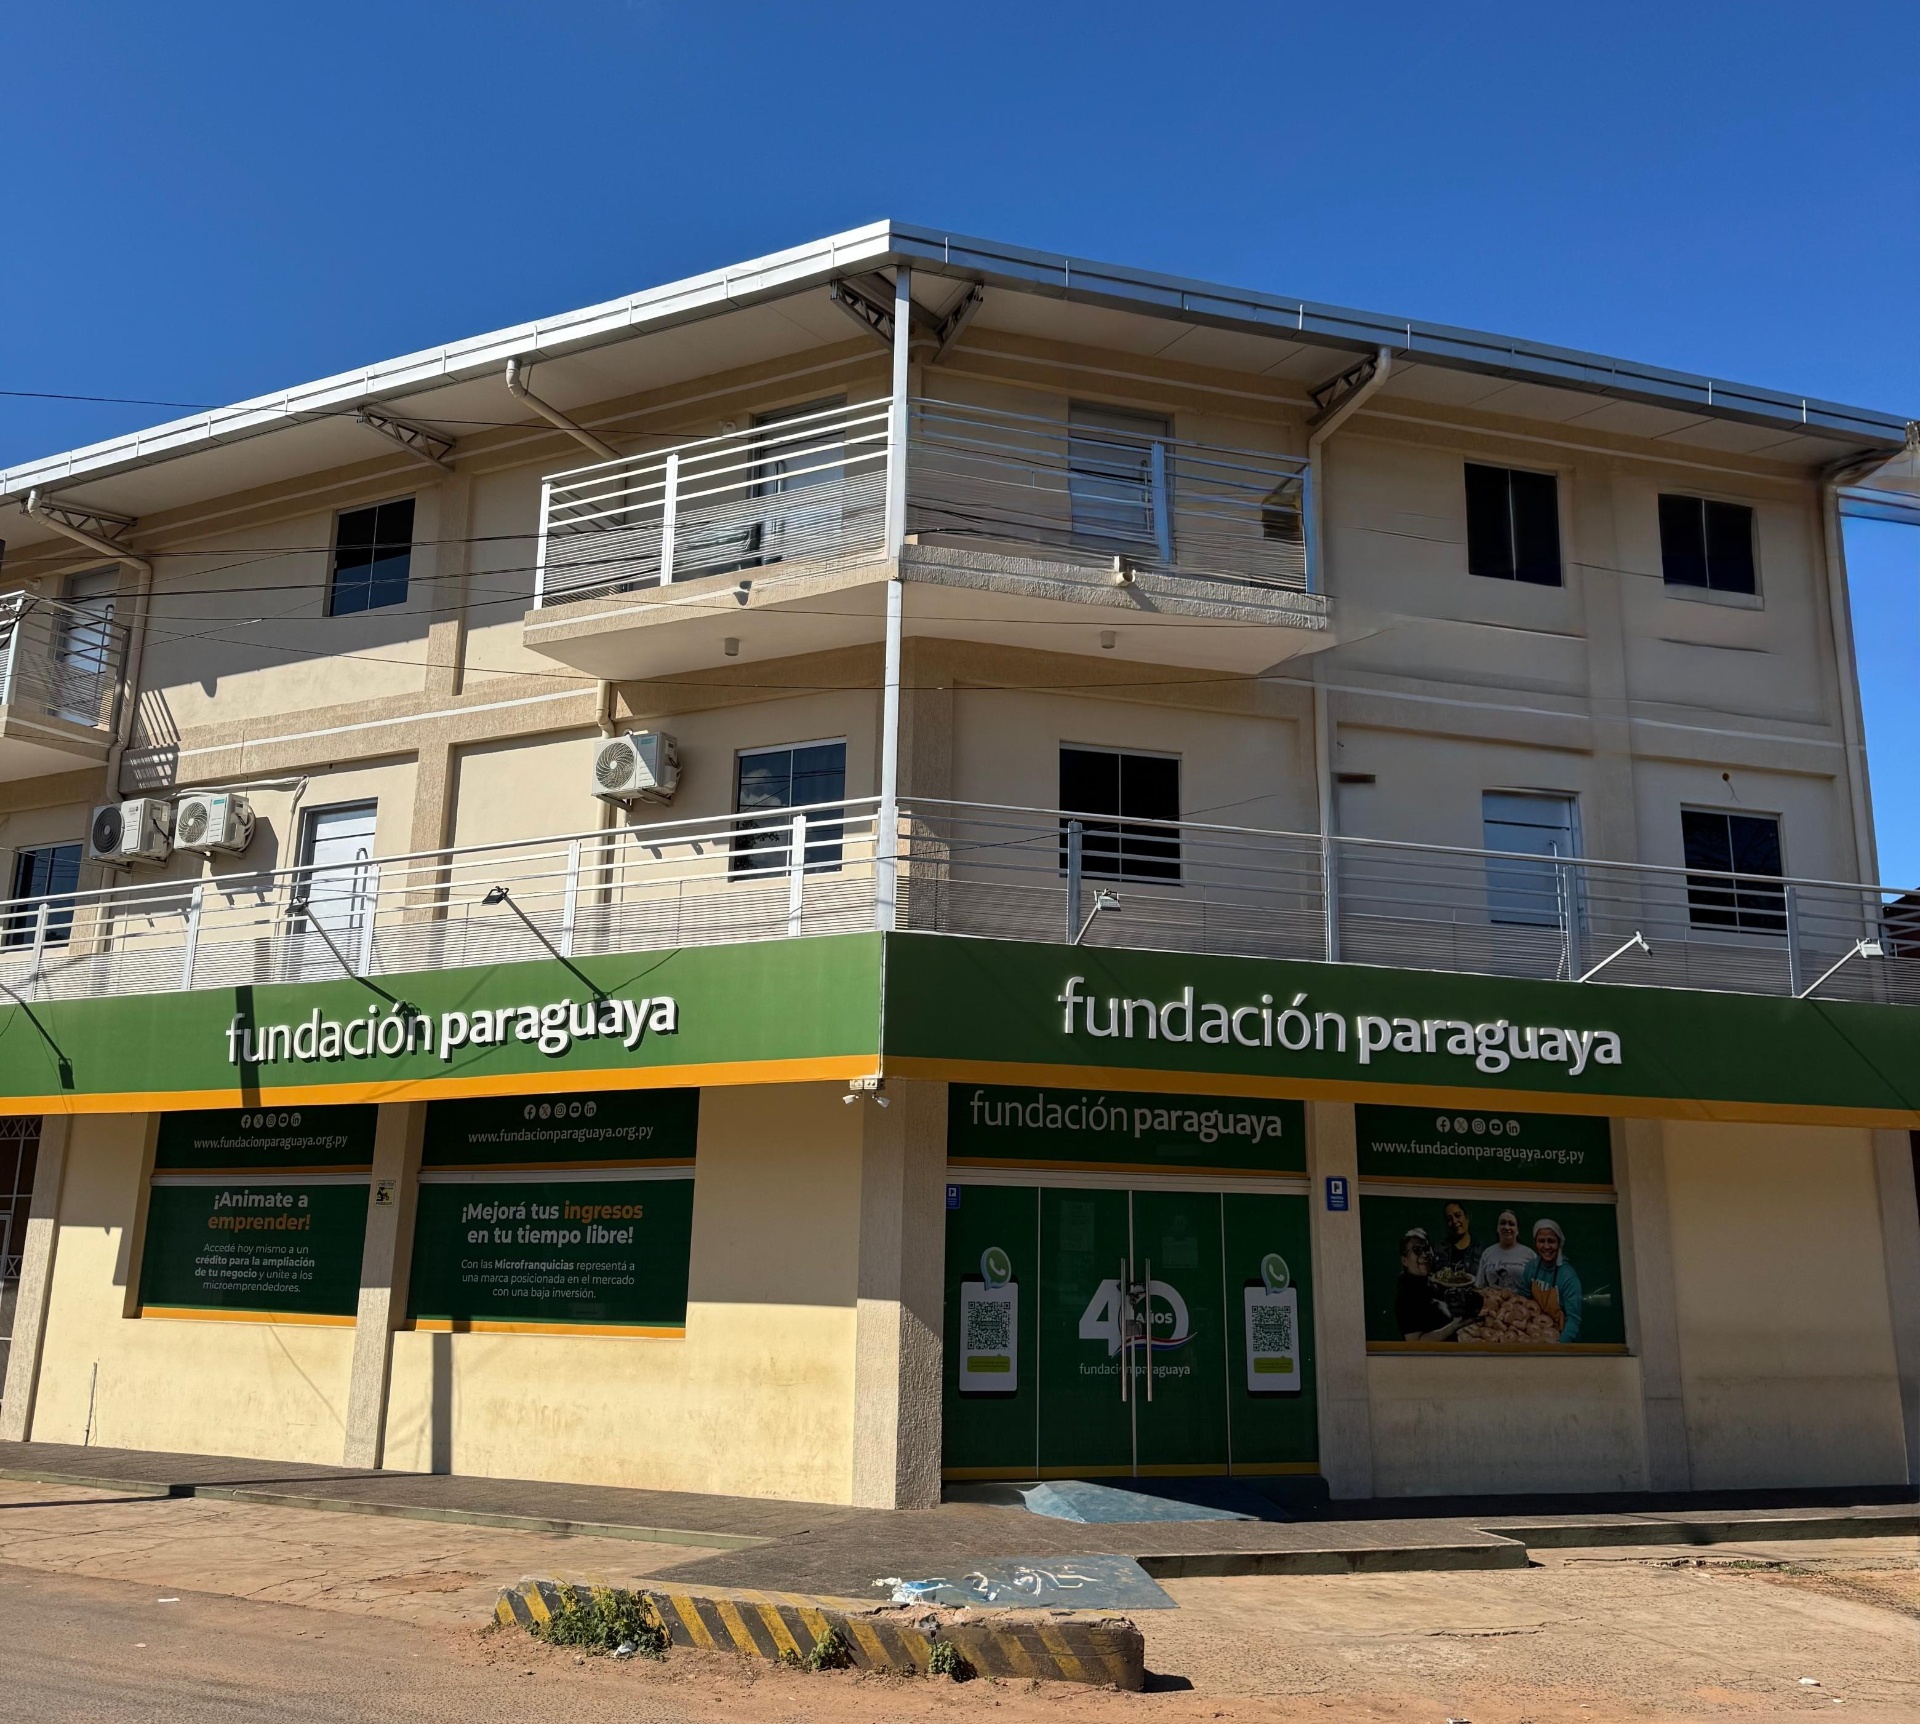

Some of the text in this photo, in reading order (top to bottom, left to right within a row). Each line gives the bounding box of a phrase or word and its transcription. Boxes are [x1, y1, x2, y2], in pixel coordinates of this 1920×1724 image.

[226, 996, 678, 1063] fundación paraguaya
[1058, 976, 1622, 1075] fundación paraguaya
[970, 1090, 1282, 1143] fundación paraguaya
[194, 1134, 348, 1150] www.fundacionparaguaya.org.py
[468, 1125, 653, 1143] www.fundacionparaguaya.org.py
[1371, 1140, 1585, 1164] www.fundacionparaguaya.org.py
[214, 1190, 308, 1209] ¡Animate a
[462, 1200, 643, 1224] ¡Mejorá tus ingresos
[208, 1214, 311, 1233] emprender!
[467, 1225, 634, 1247] en tu tiempo libre!
[203, 1243, 235, 1253] Accedé
[238, 1244, 253, 1255] hoy
[256, 1244, 286, 1254] mismo
[195, 1255, 315, 1269] crédito para la ampliación
[461, 1259, 635, 1273] Con las Microfranquicias representá a
[195, 1268, 206, 1277] de
[208, 1269, 218, 1277] tu
[220, 1268, 257, 1280] negocio
[258, 1271, 265, 1280] y
[300, 1270, 313, 1280] los
[481, 1275, 508, 1283] marca
[511, 1273, 565, 1285] posicionada
[568, 1276, 579, 1284] en
[582, 1274, 590, 1284] el
[592, 1275, 634, 1285] mercado
[203, 1281, 301, 1292] microemprendedores.
[493, 1288, 596, 1299] con una baja inversión.
